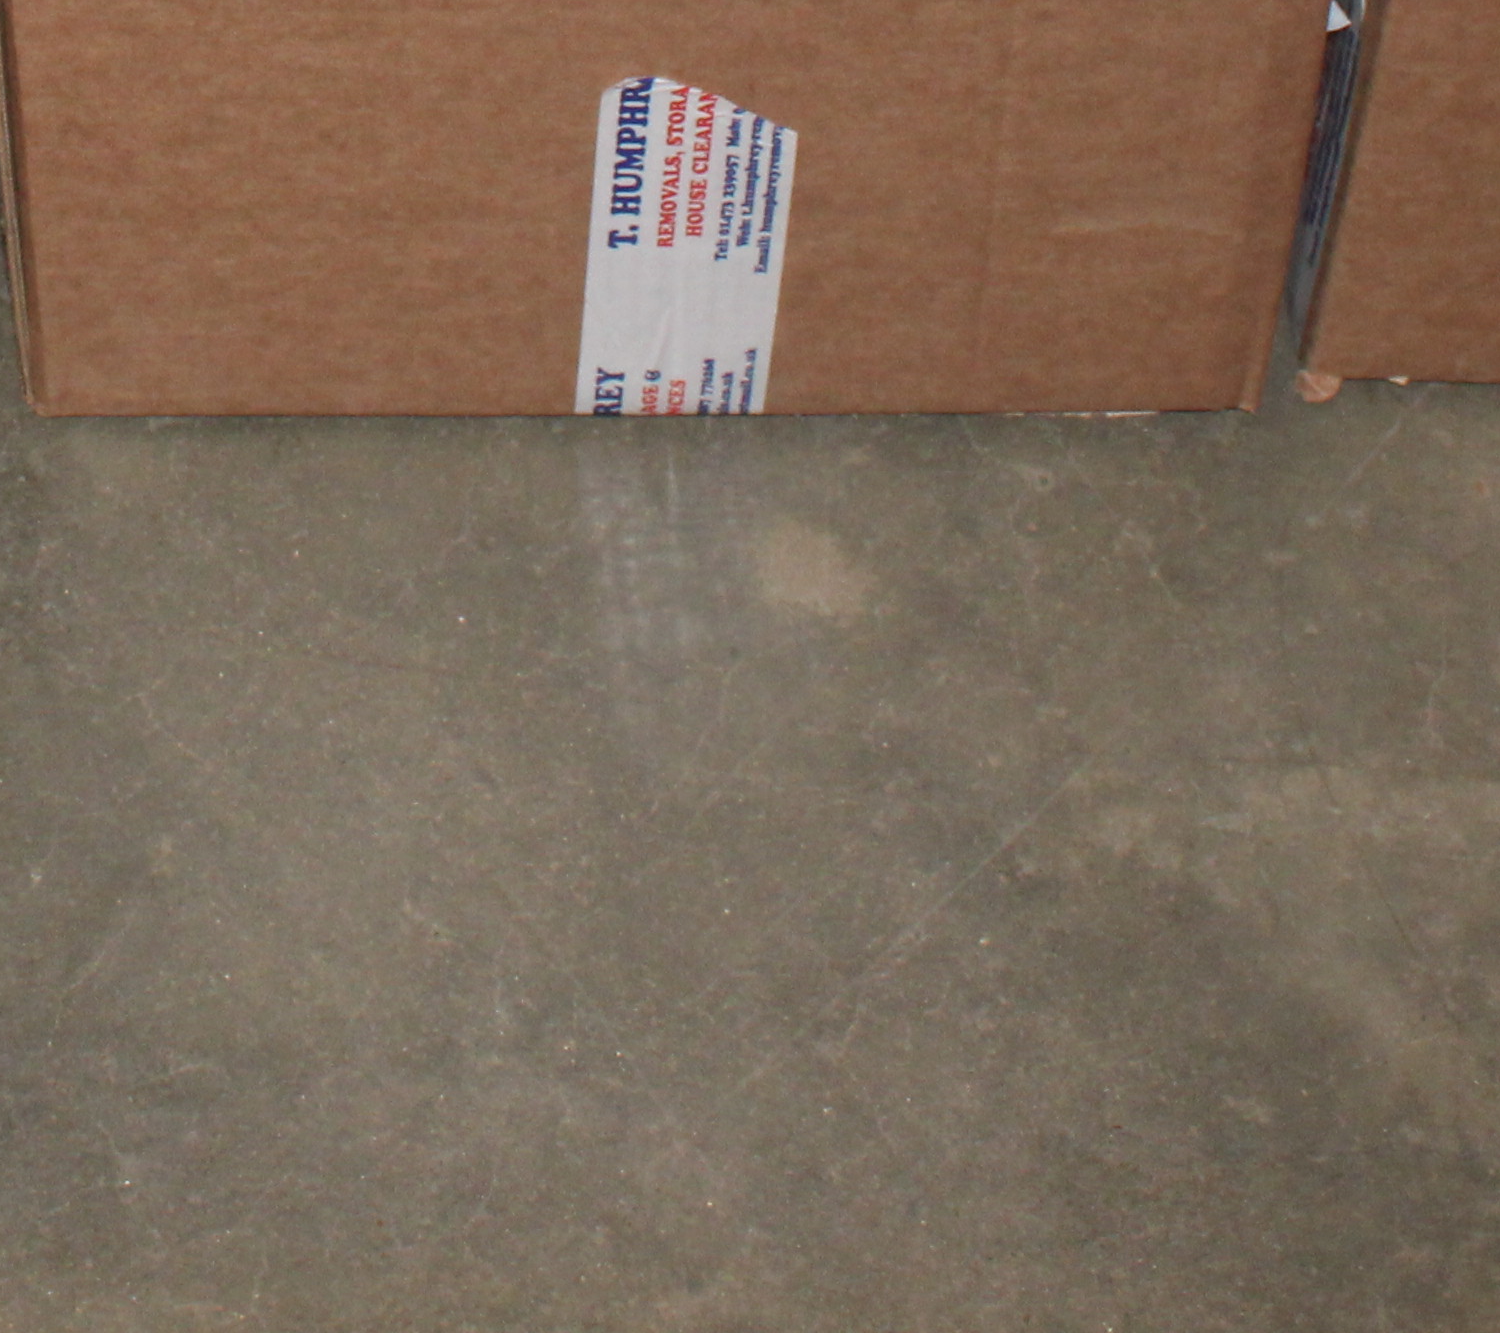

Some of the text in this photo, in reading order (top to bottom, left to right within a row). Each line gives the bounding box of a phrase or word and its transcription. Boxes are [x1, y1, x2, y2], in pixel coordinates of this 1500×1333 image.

[607, 77, 656, 250] T. HUMPHR
[656, 150, 687, 248] REMOVALS,
[685, 179, 710, 237] HOUSE
